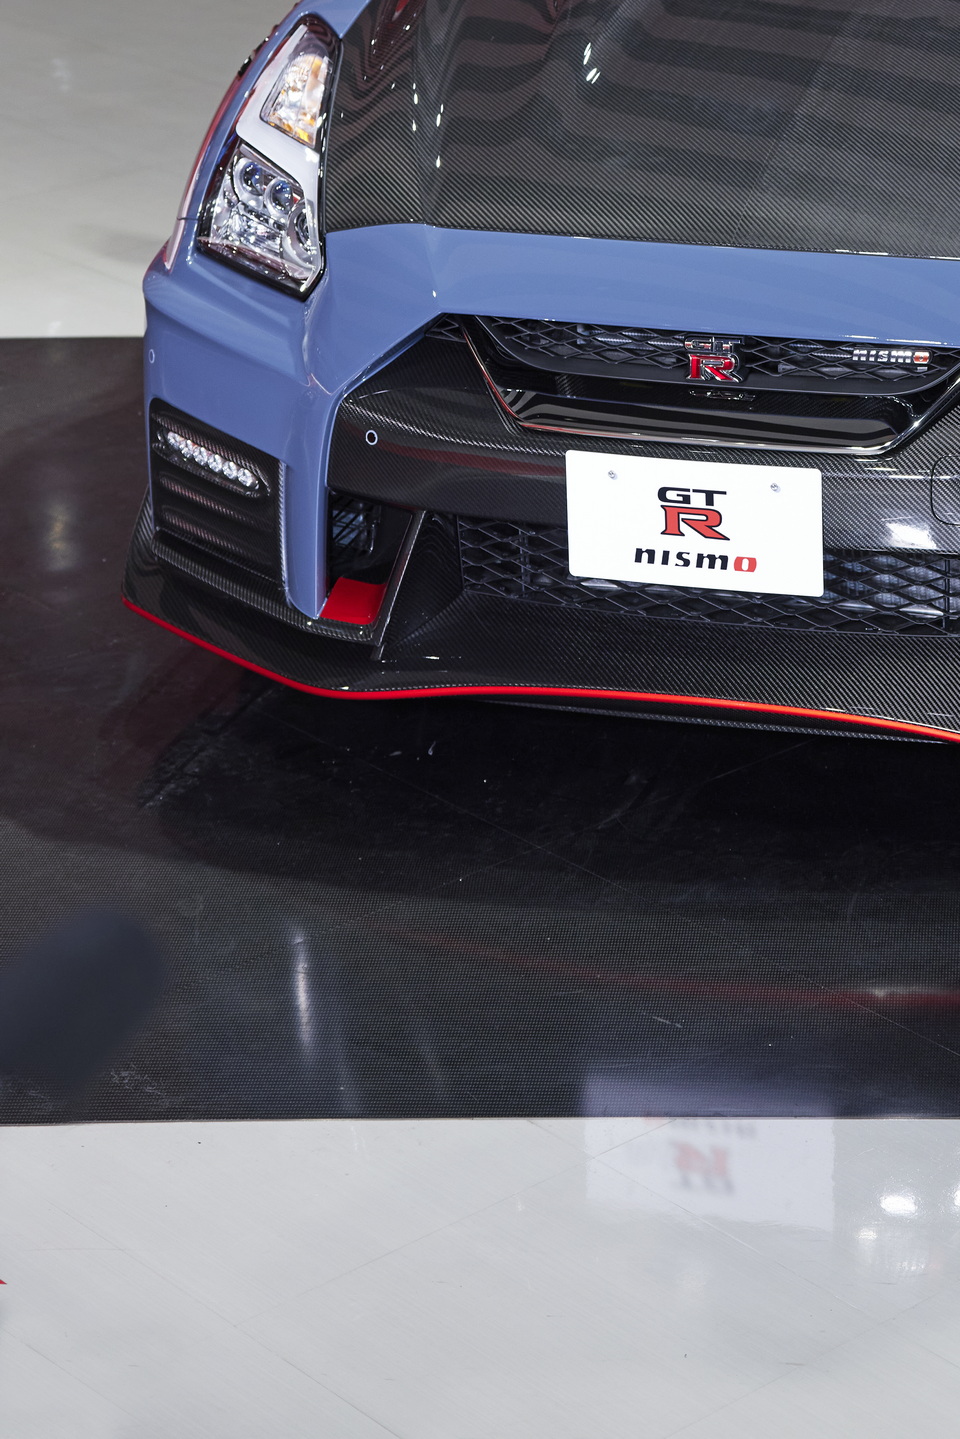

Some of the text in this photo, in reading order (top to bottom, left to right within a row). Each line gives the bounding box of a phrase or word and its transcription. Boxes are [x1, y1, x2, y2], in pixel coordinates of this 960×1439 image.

[657, 486, 727, 506] GT
[660, 504, 731, 541] R
[633, 547, 757, 573] nismo
